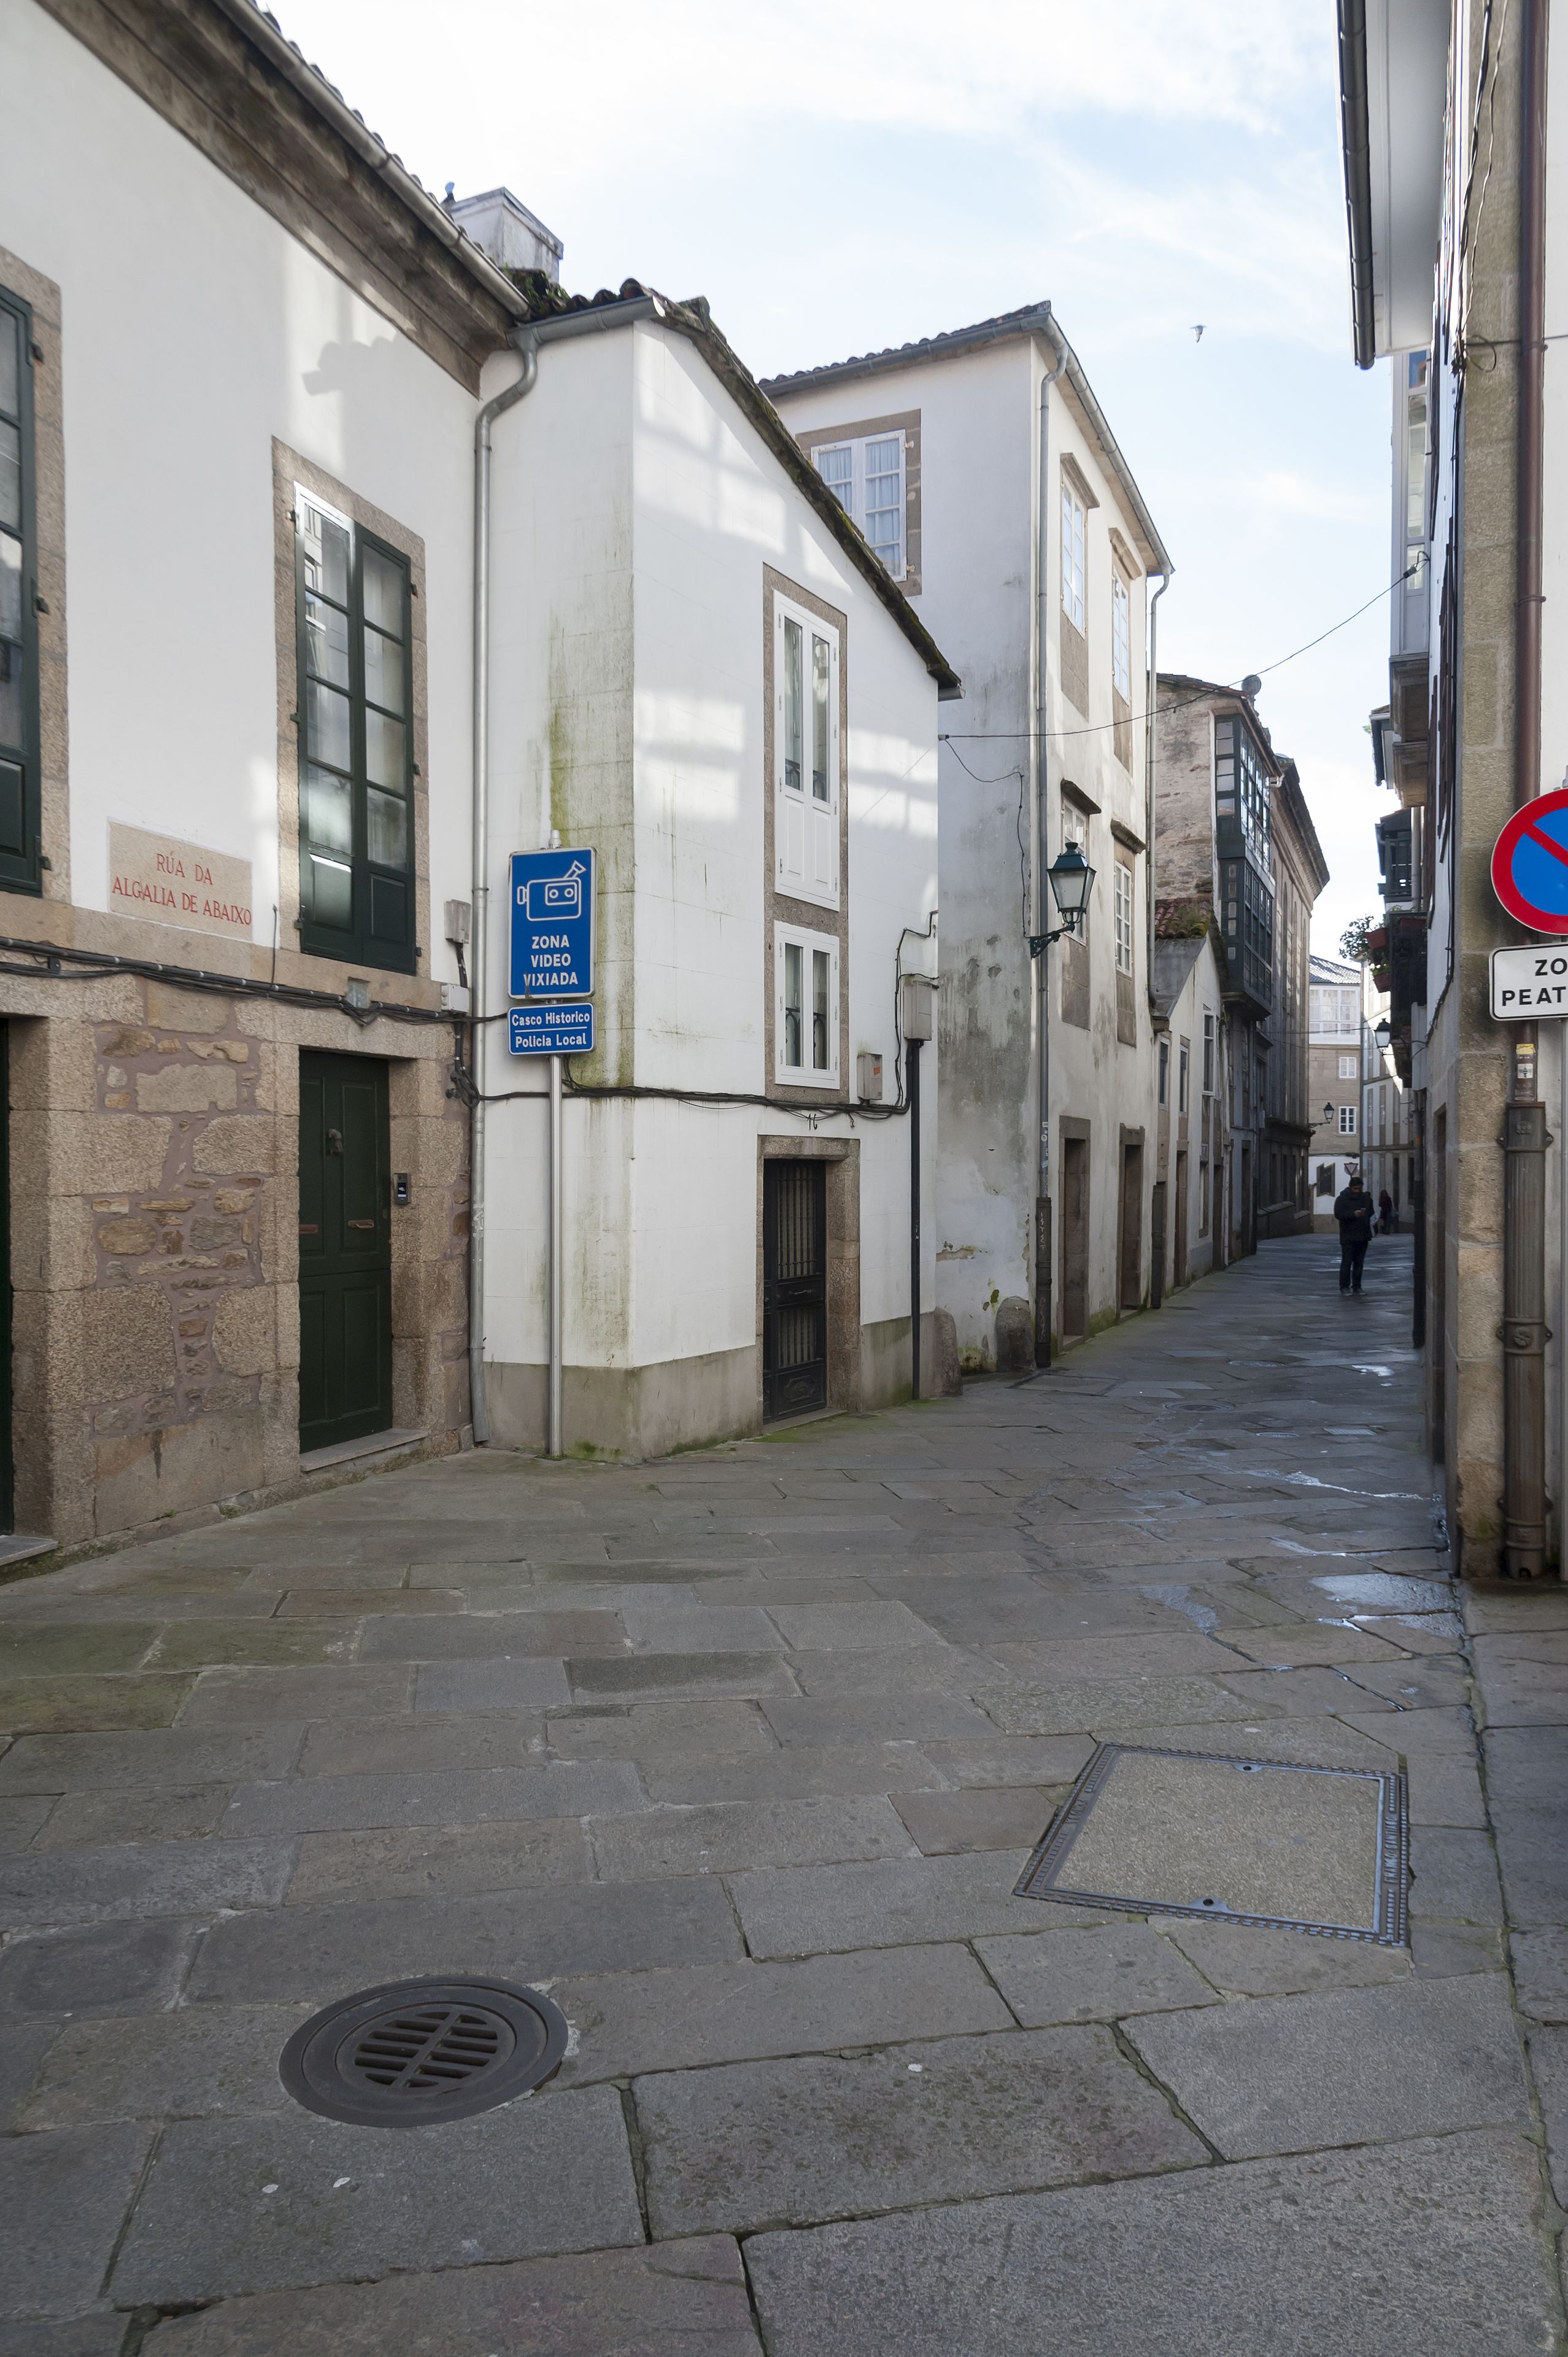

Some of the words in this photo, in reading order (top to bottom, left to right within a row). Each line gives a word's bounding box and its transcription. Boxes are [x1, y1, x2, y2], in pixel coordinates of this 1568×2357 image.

[156, 851, 185, 878] RÚA
[195, 864, 214, 885] DA
[112, 877, 177, 908] ALGALIA
[182, 892, 198, 913] DE
[203, 900, 252, 926] ABAIXO
[531, 934, 570, 950] ZONA
[530, 953, 571, 968] VIDEO
[1534, 958, 1568, 977] ZO
[523, 972, 579, 987] VIXIADA
[1502, 986, 1567, 1007] PEAT
[511, 1014, 542, 1026] Casco
[545, 1010, 590, 1024] Historico
[515, 1034, 552, 1048] Policia
[556, 1032, 587, 1046] Local
[807, 1113, 817, 1131] 16
